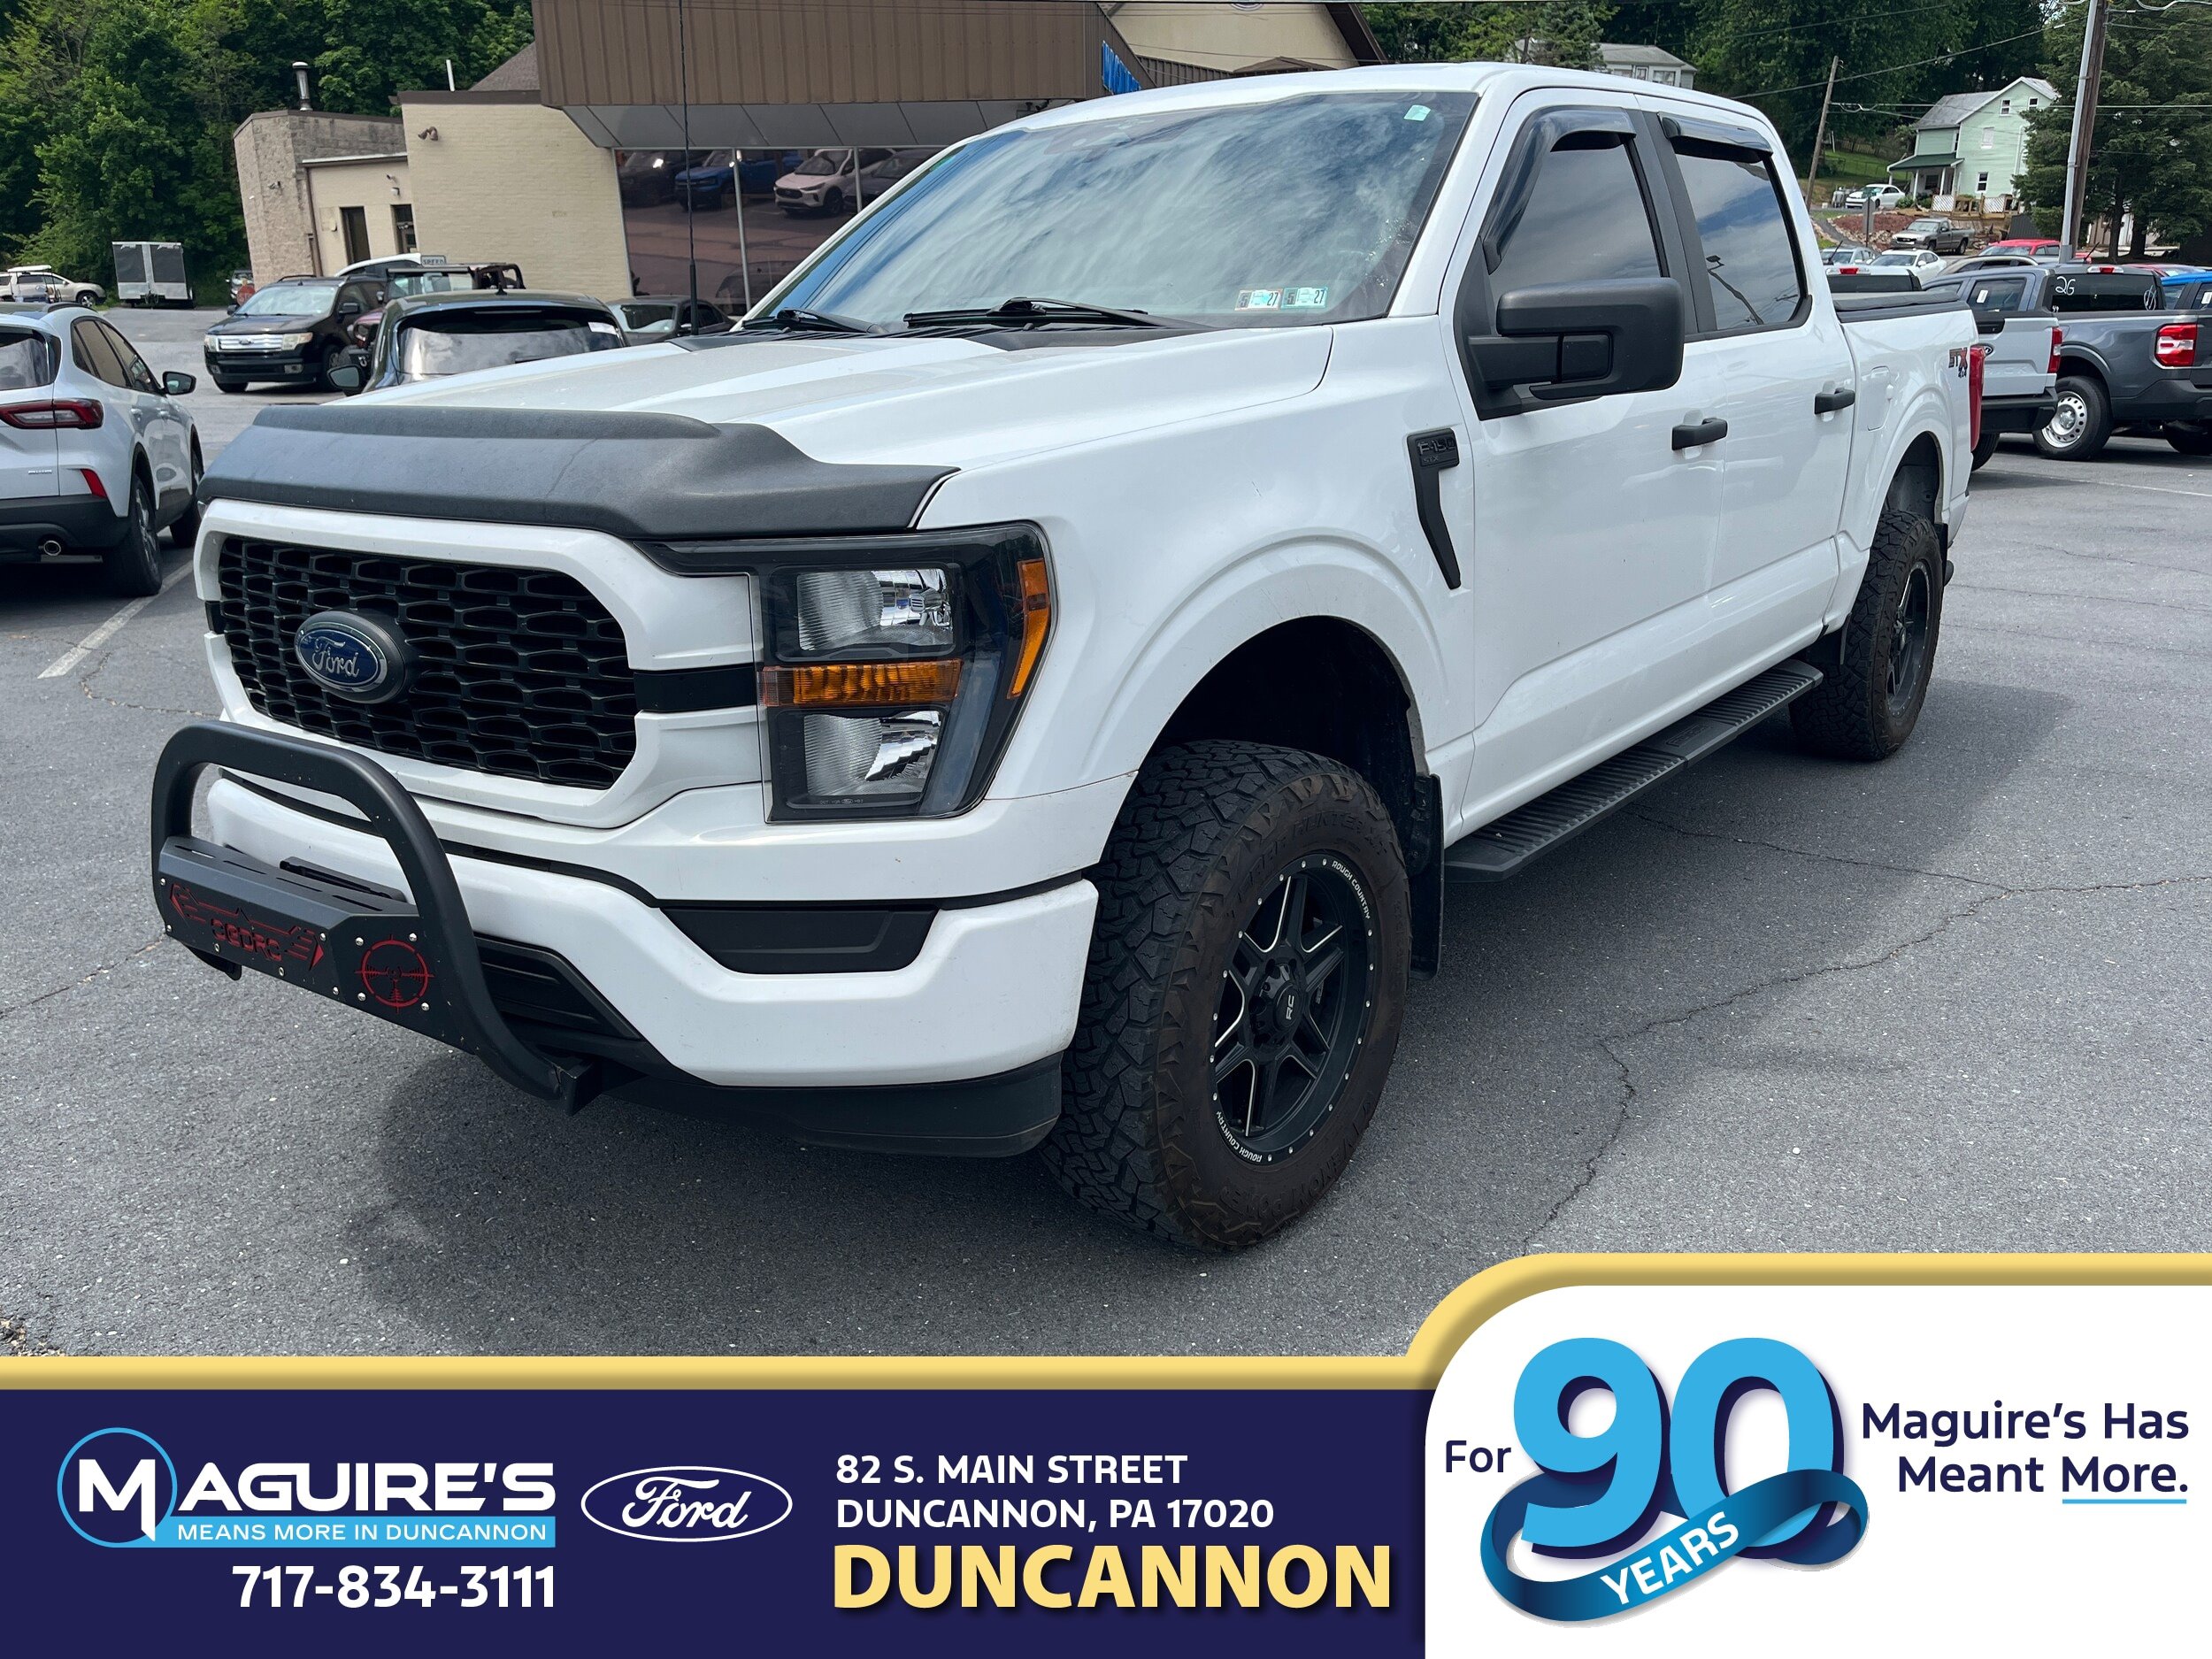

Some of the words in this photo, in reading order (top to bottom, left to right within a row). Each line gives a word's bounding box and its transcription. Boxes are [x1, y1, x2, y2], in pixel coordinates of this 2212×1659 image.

[1267, 292, 1279, 307] 27
[1314, 289, 1325, 304] 27
[1948, 346, 1969, 373] STX
[1417, 438, 1456, 455] F-150
[311, 635, 360, 678] Ford
[1332, 860, 1353, 880] ROUGH
[1351, 879, 1371, 919] COUNTRY
[1286, 995, 1294, 1020] RC
[1216, 1110, 1240, 1150] COUNTRY
[1239, 1147, 1263, 1163] ROUGH
